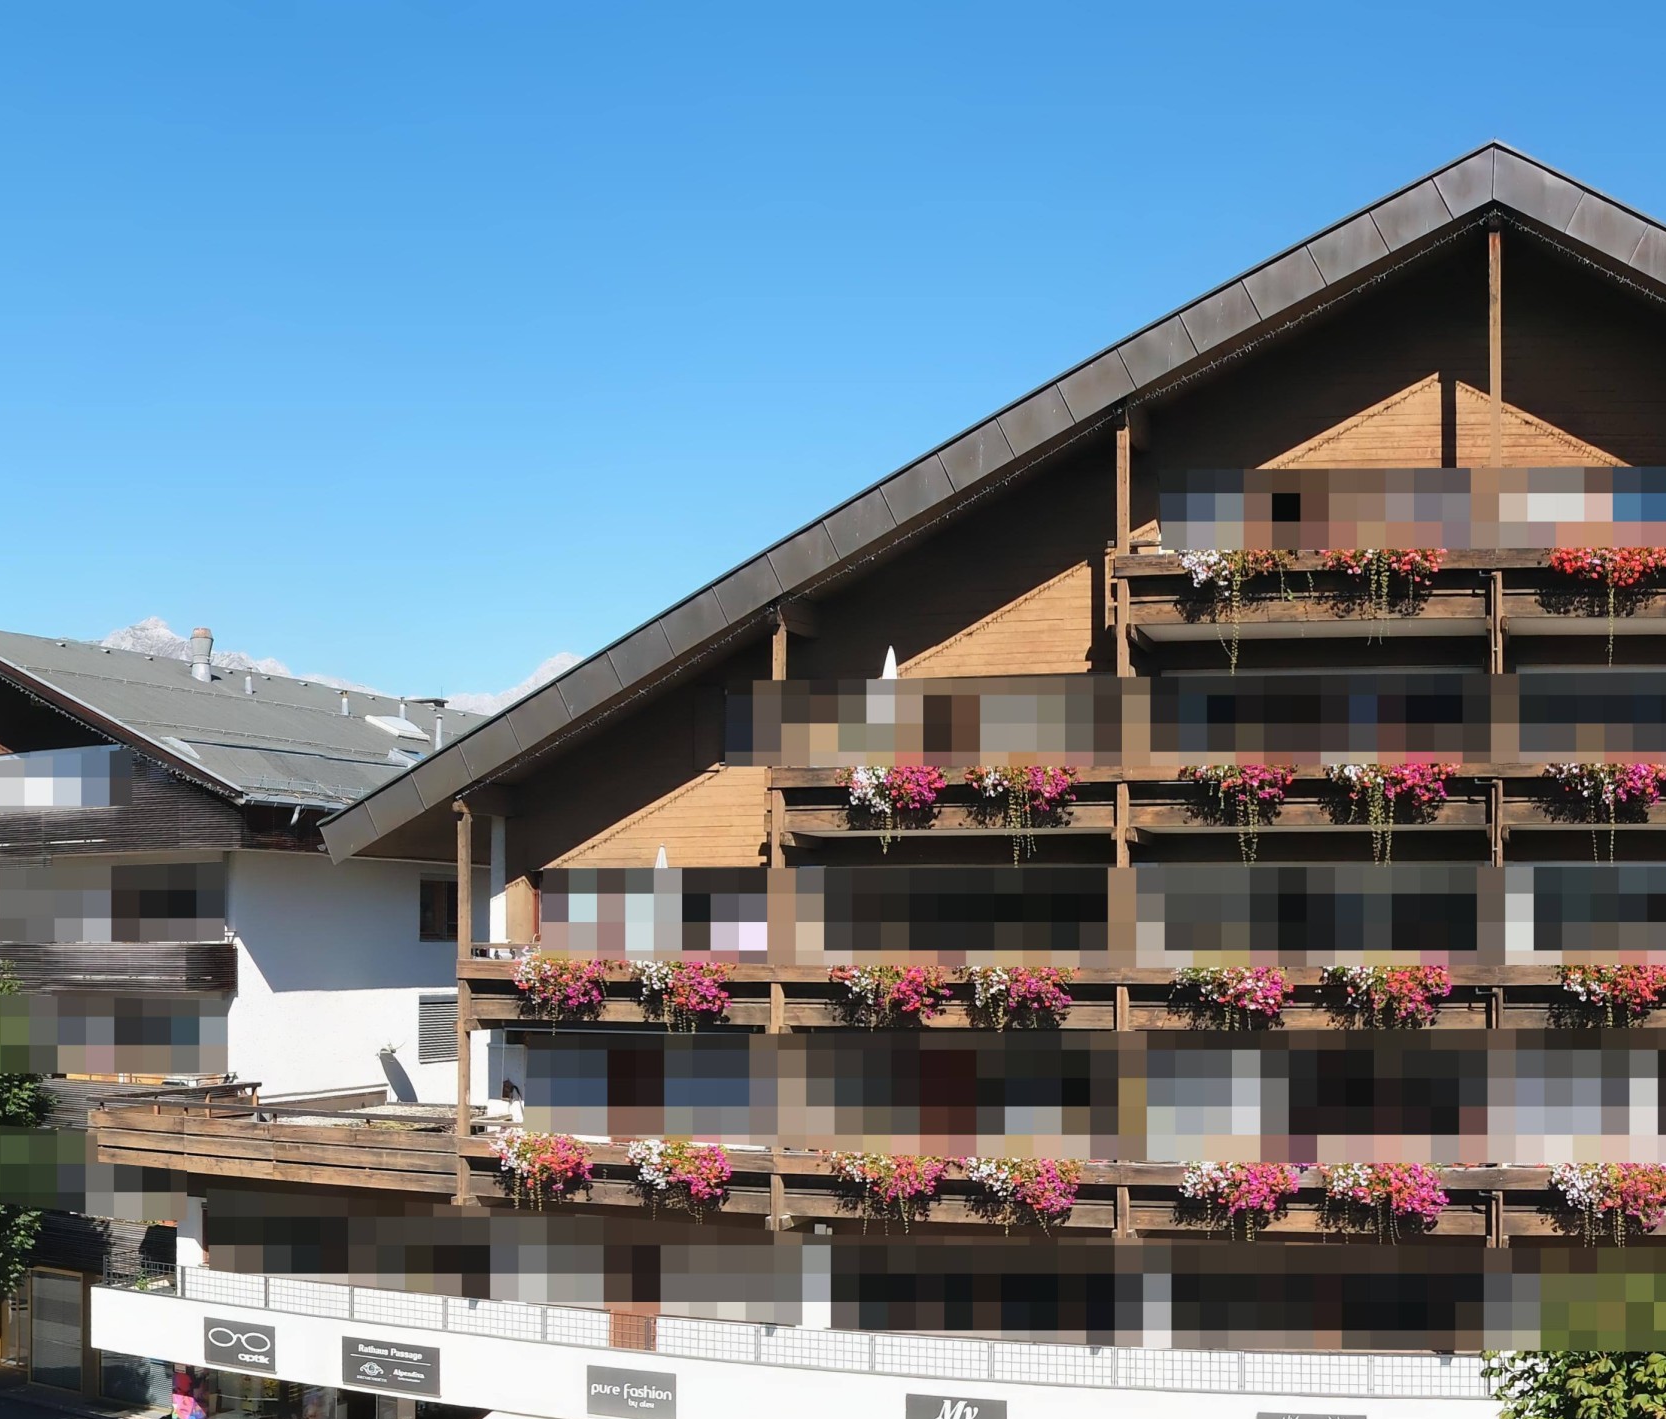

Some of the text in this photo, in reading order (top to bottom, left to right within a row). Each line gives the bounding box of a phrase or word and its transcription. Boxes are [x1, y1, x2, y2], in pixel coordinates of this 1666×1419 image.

[237, 1353, 271, 1365] optik
[358, 1344, 423, 1361] Rathaus Passage
[591, 1383, 672, 1400] pure fashion
[628, 1399, 638, 1409] by
